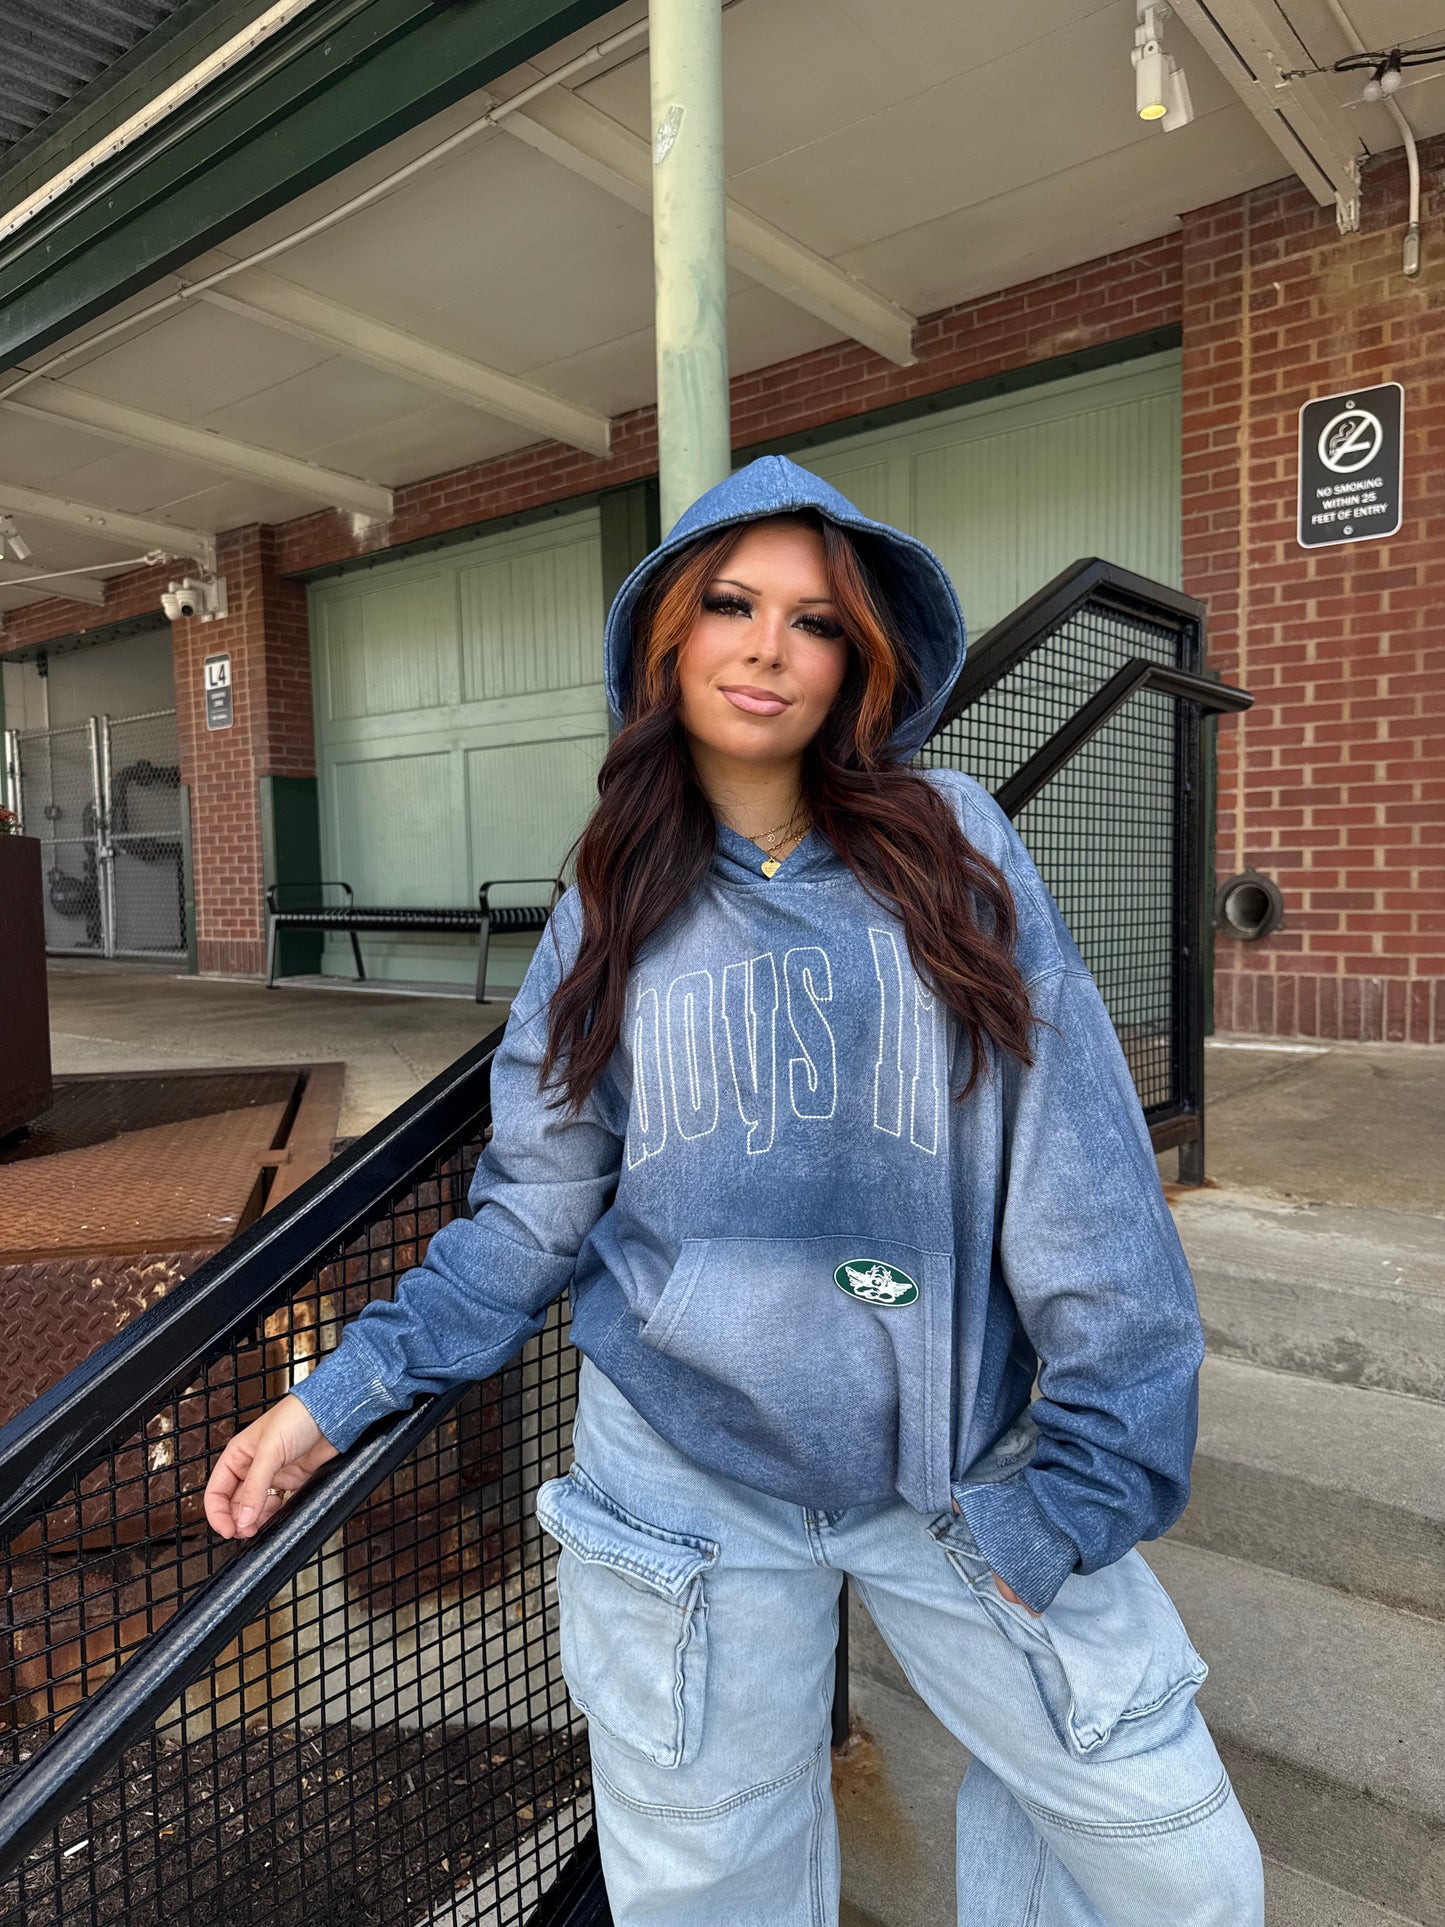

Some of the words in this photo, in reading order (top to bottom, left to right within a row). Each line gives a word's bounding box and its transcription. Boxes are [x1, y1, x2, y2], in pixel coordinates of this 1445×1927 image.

[1316, 486, 1332, 498] NO
[1334, 477, 1383, 495] SMOKING
[1323, 497, 1360, 510] WITHIN
[1361, 491, 1377, 504] 25
[1311, 512, 1336, 525] FEET
[1338, 508, 1353, 520] OF
[1353, 503, 1388, 517] ENTRY
[208, 664, 226, 687] L4
